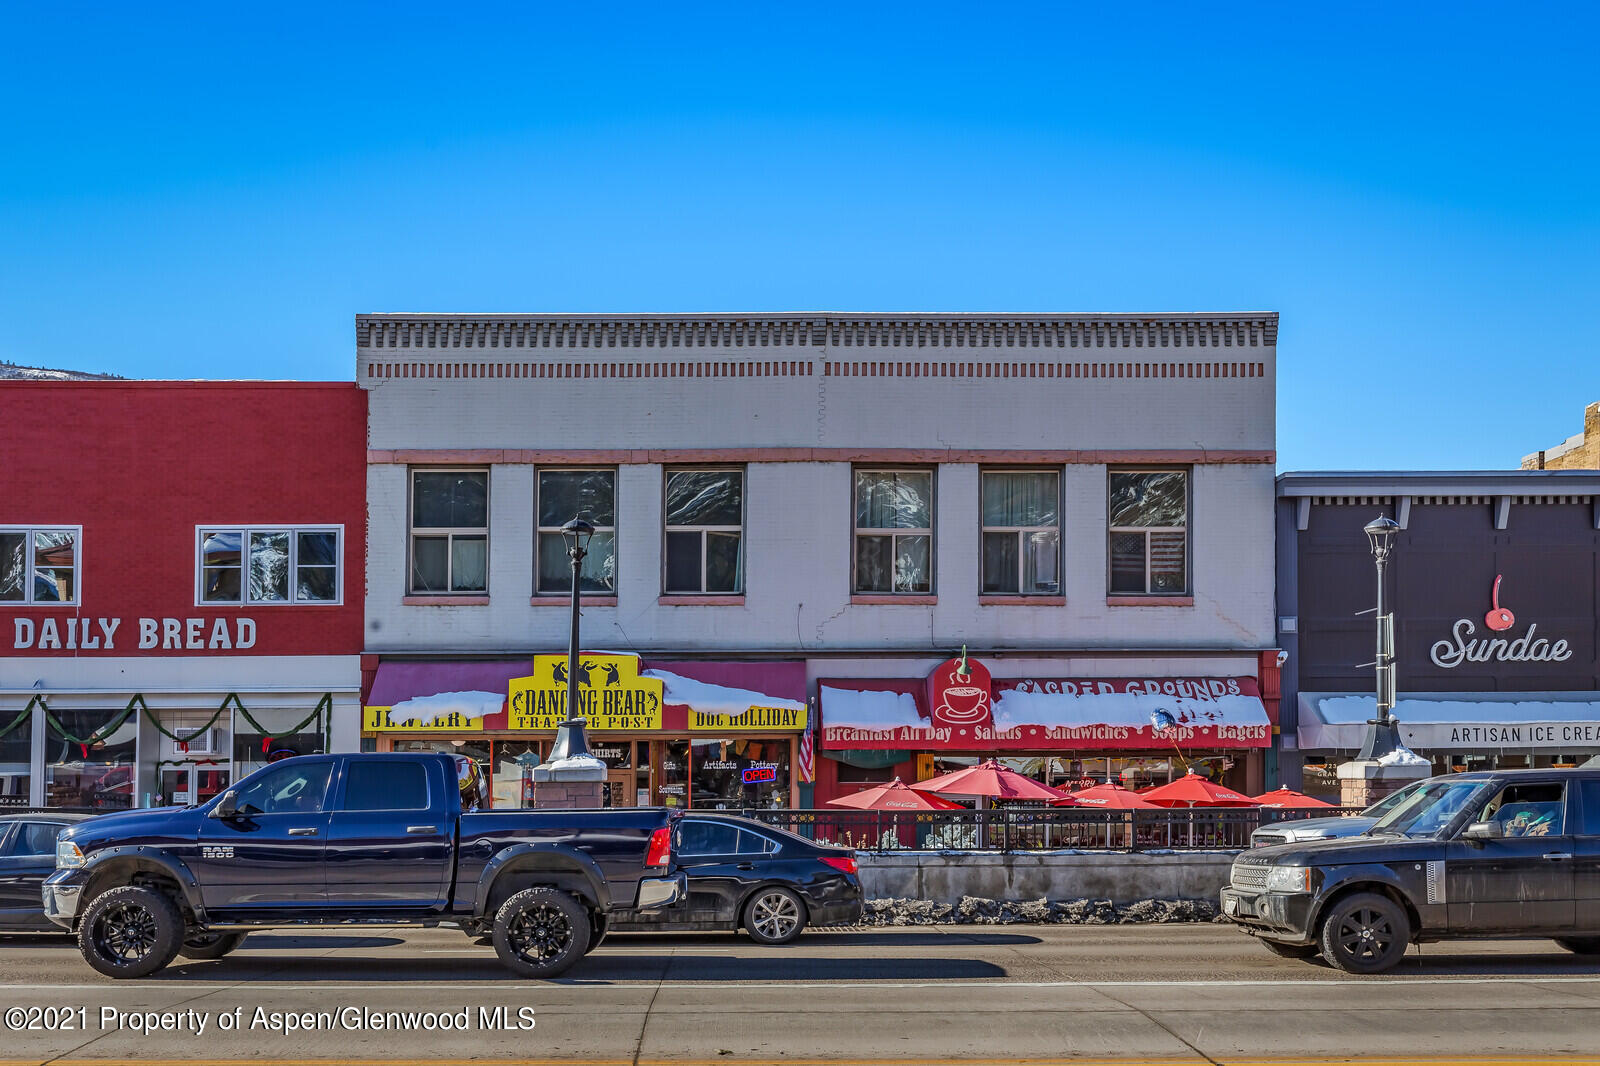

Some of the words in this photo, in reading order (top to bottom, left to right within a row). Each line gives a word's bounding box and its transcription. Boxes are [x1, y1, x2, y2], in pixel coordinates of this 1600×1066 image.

[14, 617, 121, 649] DAILY
[139, 617, 257, 649] BREAD
[1430, 618, 1572, 668] Sundae
[525, 689, 597, 716] DANCNG
[602, 689, 646, 716] BEAR
[729, 708, 798, 726] HOLLIDAY
[925, 726, 952, 743] Day
[1044, 725, 1129, 740] Sandwiches
[1217, 725, 1266, 742] Bagels
[1451, 727, 1521, 742] ARTISAN
[1530, 726, 1554, 741] ICE
[703, 760, 737, 770] Artifacts
[750, 760, 780, 771] Pottery
[744, 769, 775, 781] OPEN
